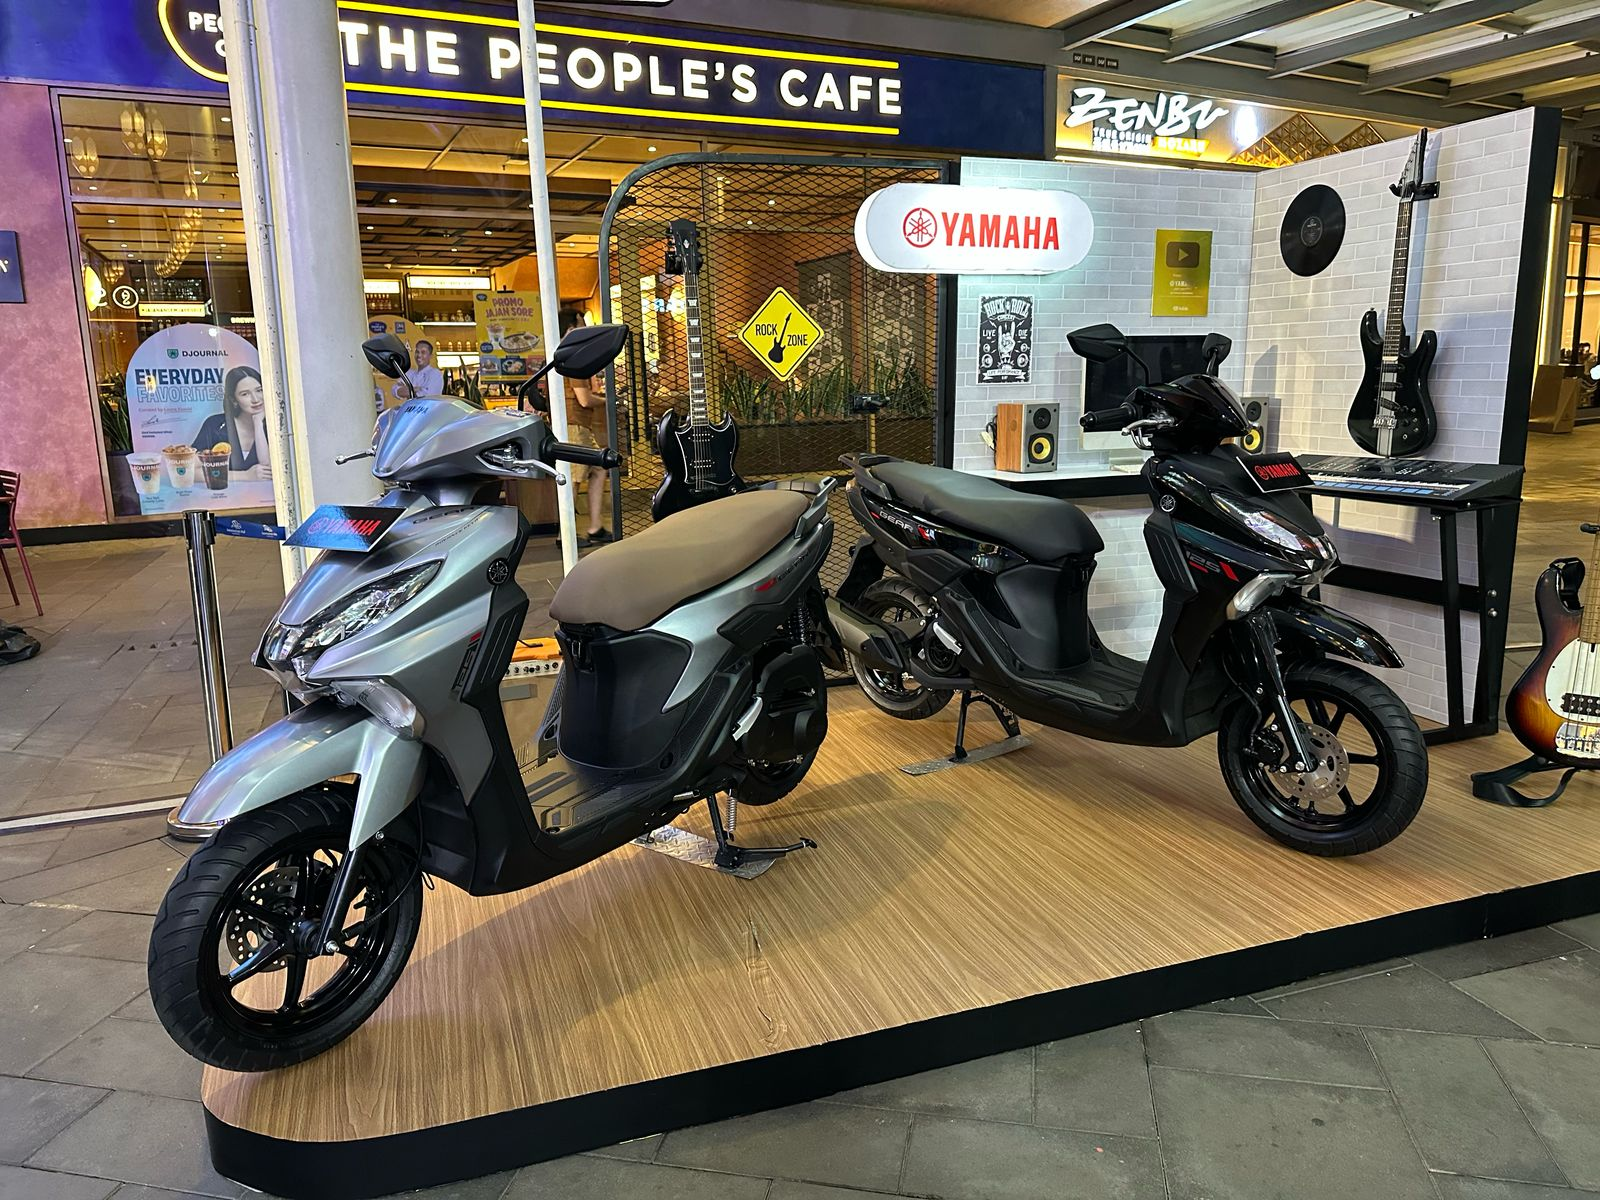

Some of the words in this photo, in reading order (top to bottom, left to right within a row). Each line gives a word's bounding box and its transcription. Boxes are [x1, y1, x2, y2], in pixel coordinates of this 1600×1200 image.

[338, 21, 460, 76] THE
[488, 37, 758, 103] PEOPLE'S
[779, 68, 902, 115] CAFE
[941, 211, 1060, 251] YAMAHA
[492, 297, 524, 308] PROMO
[983, 298, 1005, 318] ROCK
[1011, 298, 1031, 318] ROLL
[511, 307, 534, 317] SORE
[755, 323, 778, 336] ROCK
[982, 329, 997, 337] LIVE
[1018, 329, 1028, 337] DIE
[787, 334, 808, 346] ZONE
[135, 368, 225, 385] EVERYDAY
[137, 385, 225, 403] FAVORITES
[1262, 462, 1301, 479] YAMAHA
[323, 519, 381, 536] YAMAHA
[879, 510, 914, 533] GEAR
